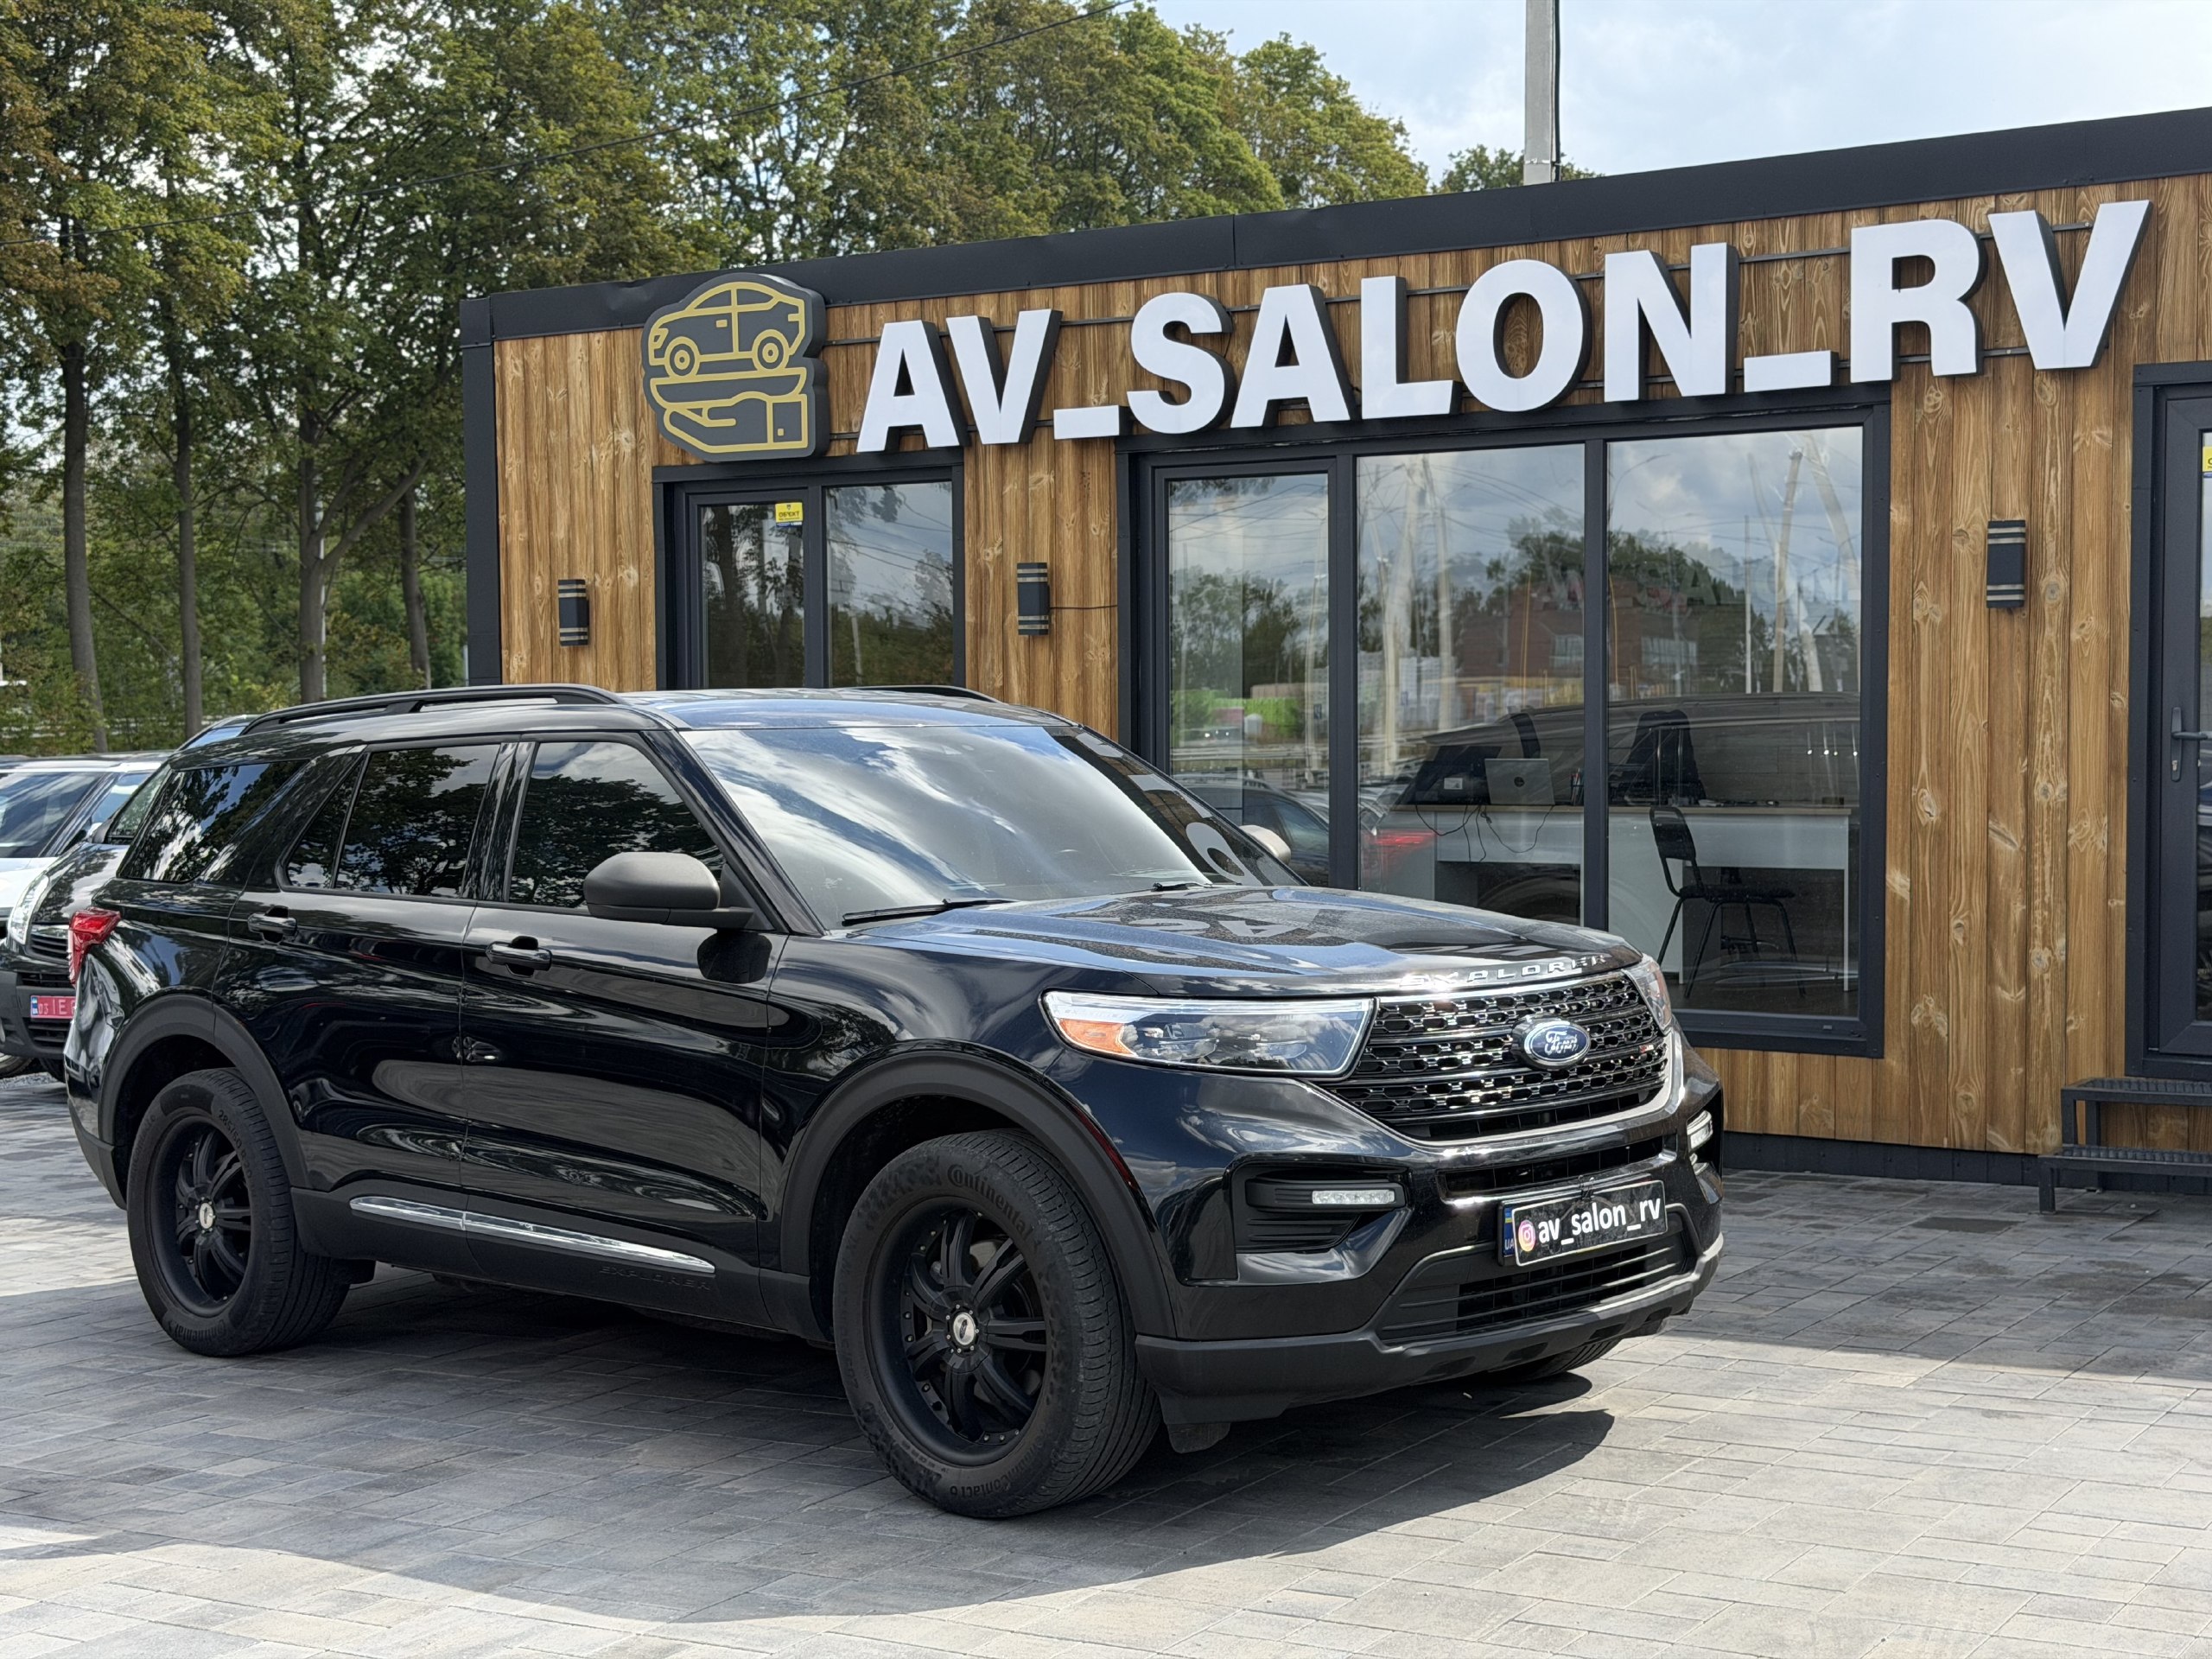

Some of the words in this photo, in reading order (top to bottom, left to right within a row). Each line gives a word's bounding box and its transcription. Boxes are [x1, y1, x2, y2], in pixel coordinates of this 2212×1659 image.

[855, 200, 2152, 453] AV_SALON_RV
[1400, 954, 1606, 988] EXPLORER
[947, 1163, 1034, 1242] Continental
[1538, 1198, 1661, 1245] av_salon_rv
